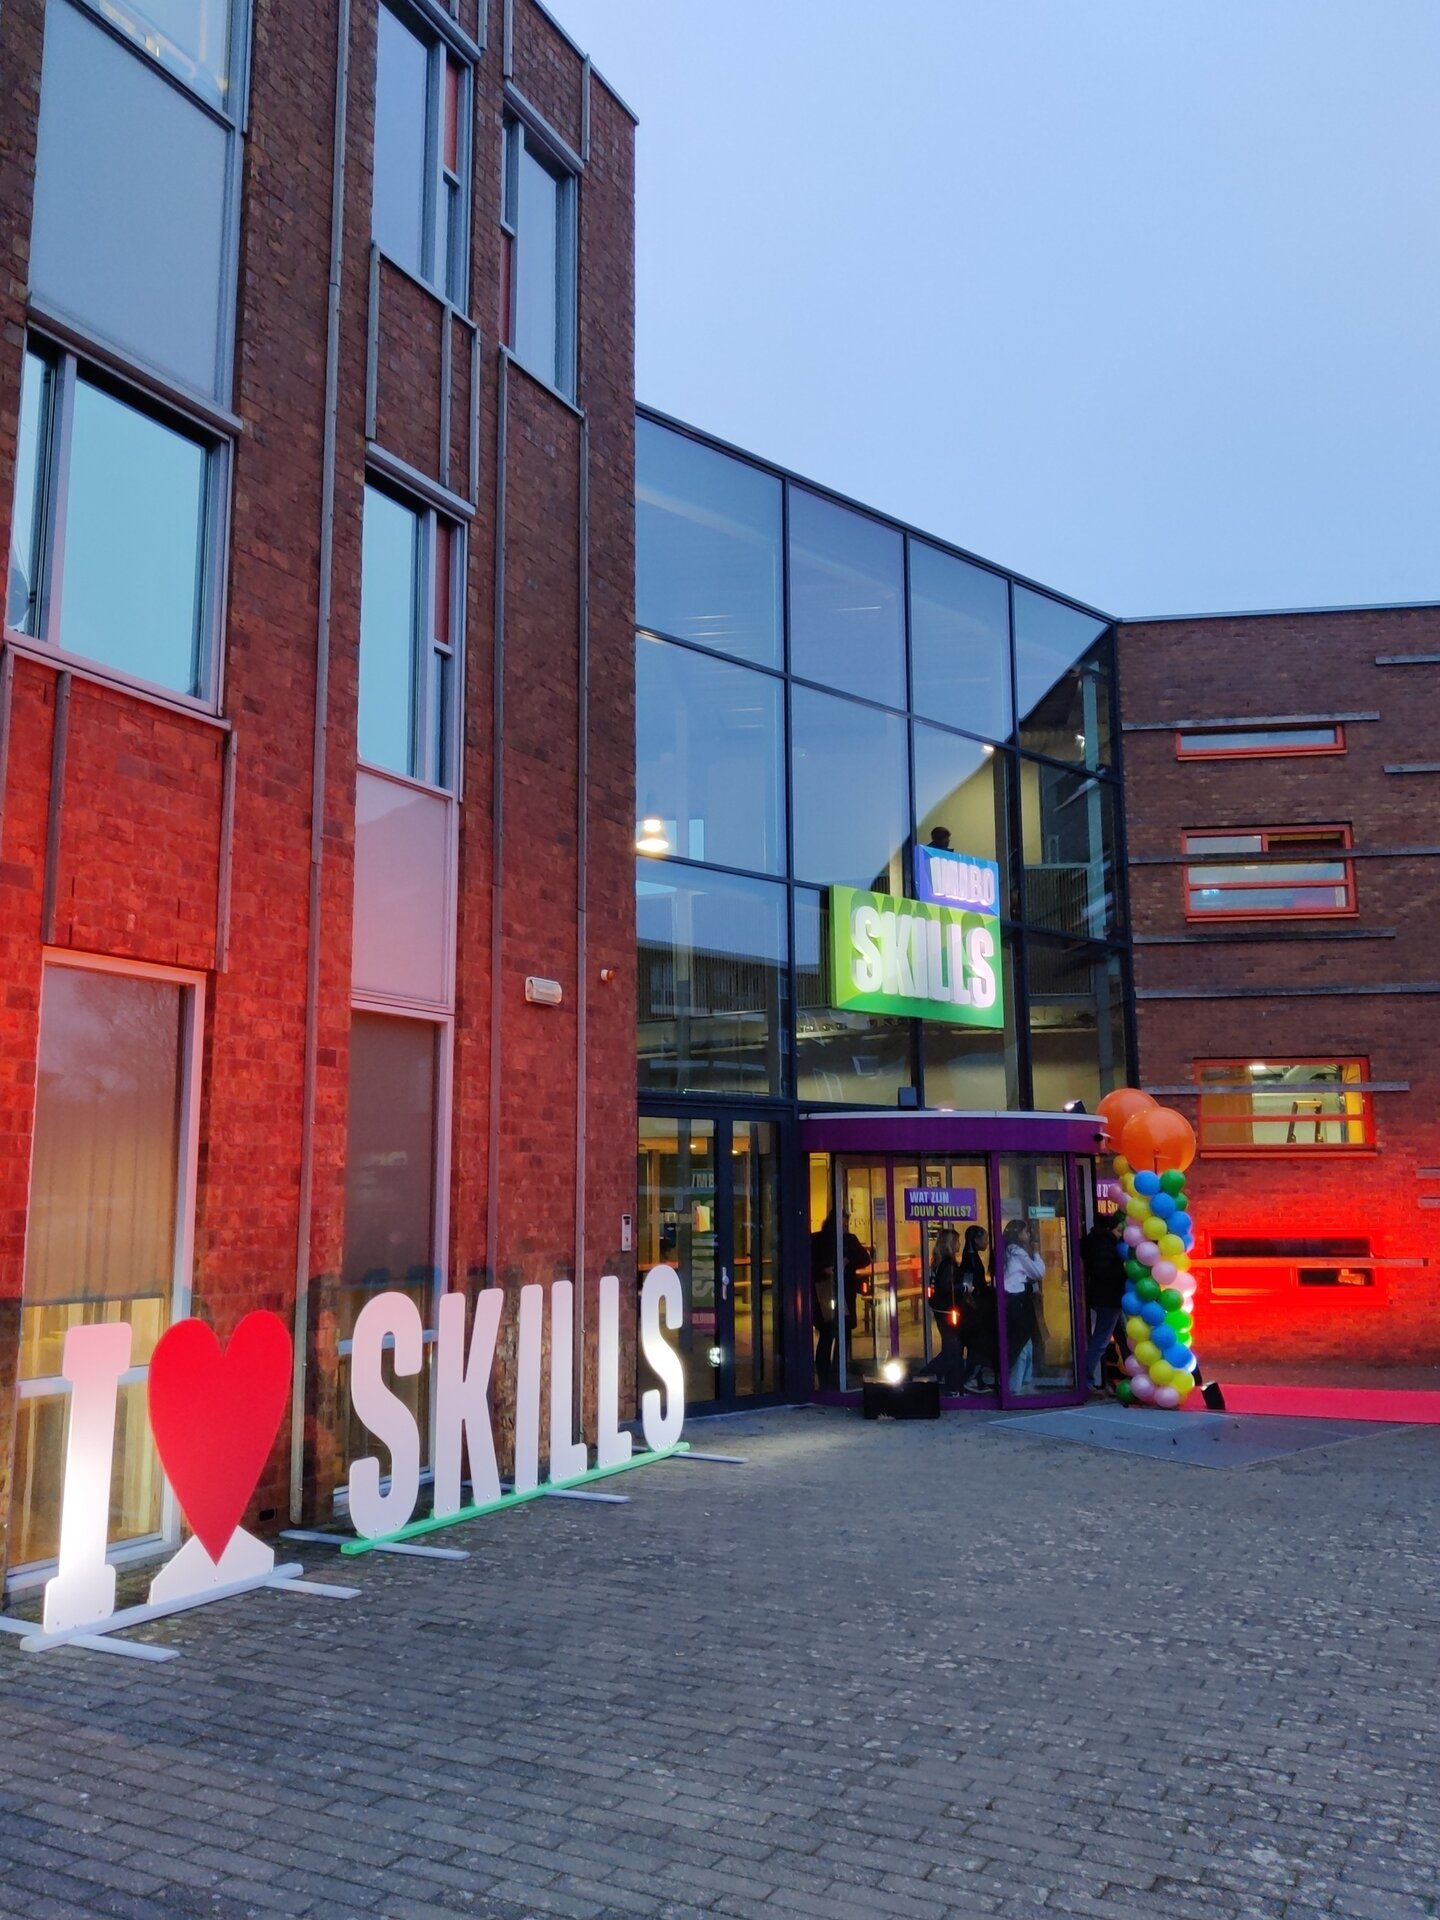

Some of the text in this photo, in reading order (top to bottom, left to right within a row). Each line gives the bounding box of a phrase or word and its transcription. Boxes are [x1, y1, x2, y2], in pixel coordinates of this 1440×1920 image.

[853, 905, 996, 1008] SKILLS
[909, 1191, 949, 1204] WAT ZIJN
[910, 1205, 972, 1217] JOUW SKILLS?
[44, 1264, 685, 1633] I SKILLS
